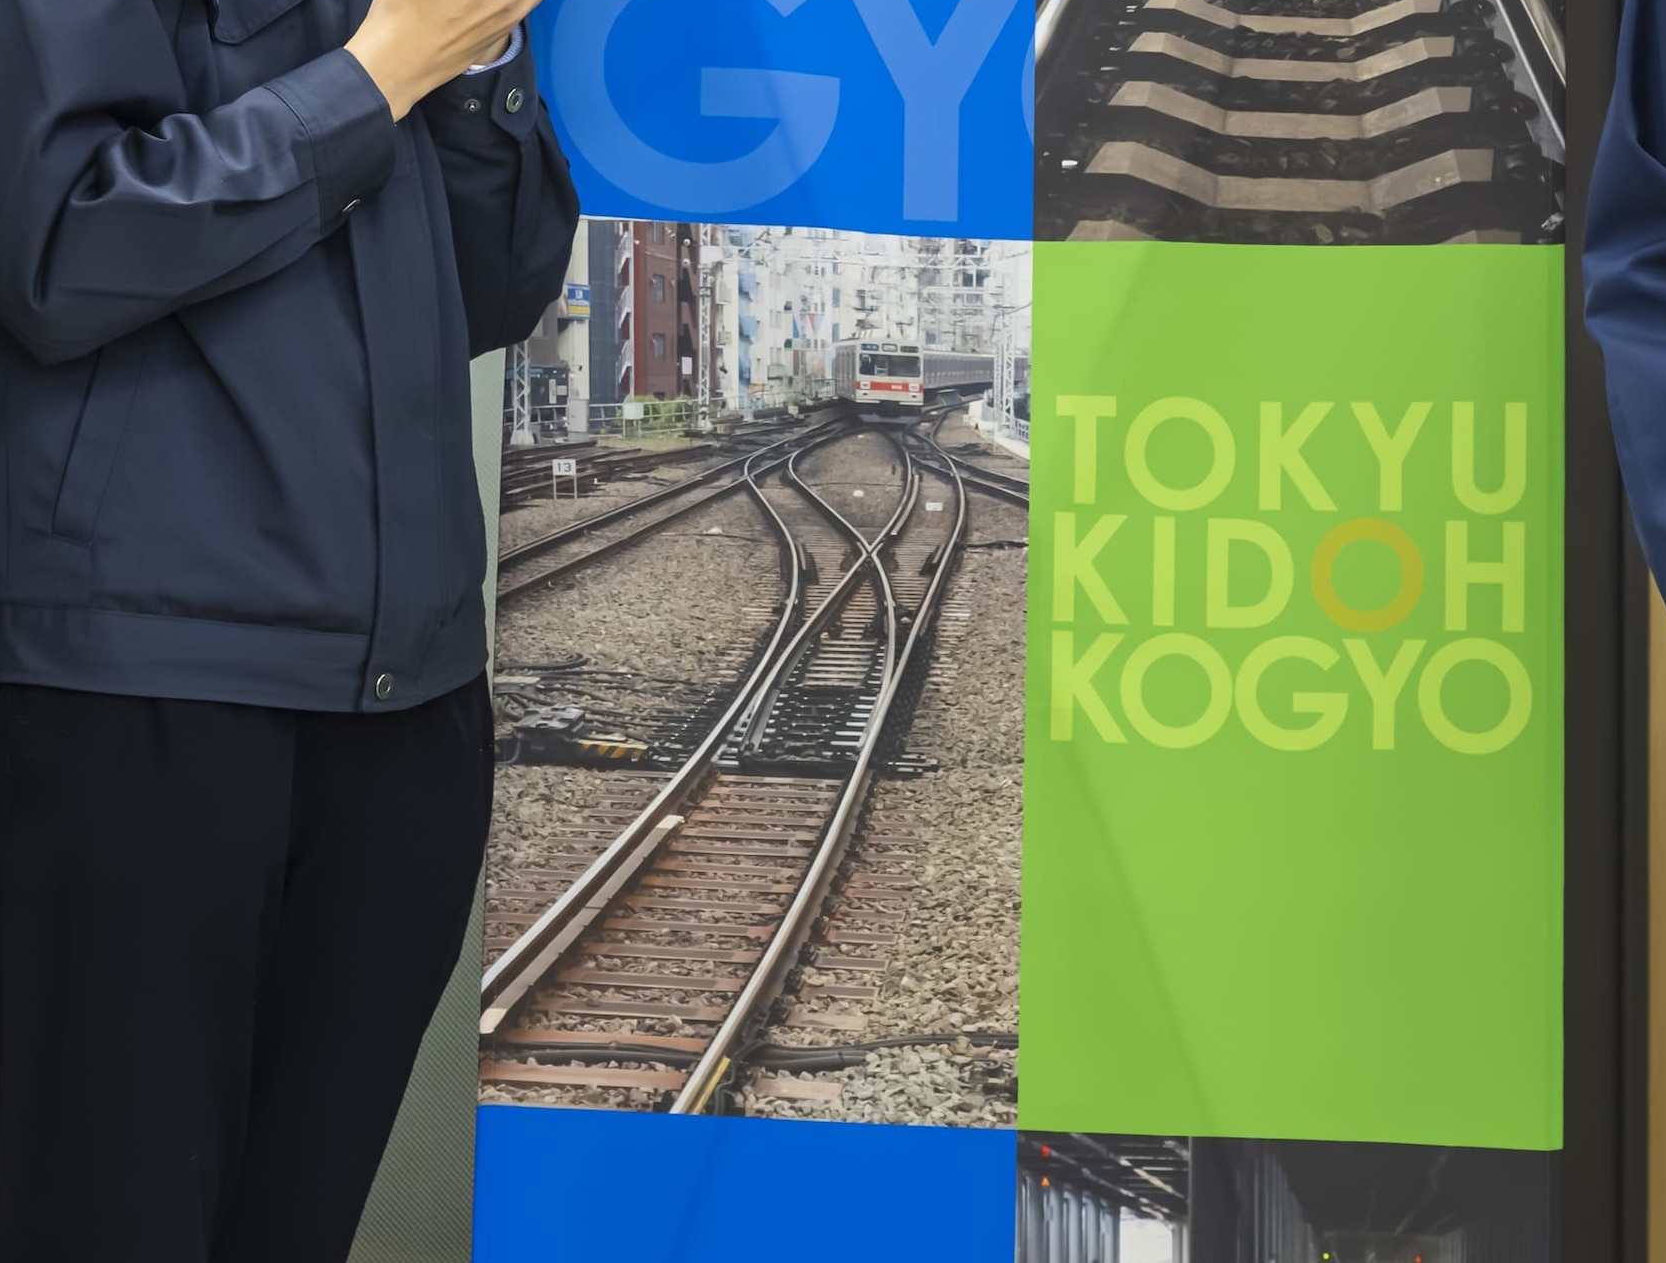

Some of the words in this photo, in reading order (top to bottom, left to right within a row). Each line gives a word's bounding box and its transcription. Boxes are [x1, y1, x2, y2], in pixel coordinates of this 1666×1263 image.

[557, 462, 572, 472] 13
[1055, 394, 1528, 515] TOKYU
[1051, 510, 1526, 633] KIDOH
[1049, 629, 1533, 755] KOGYO
